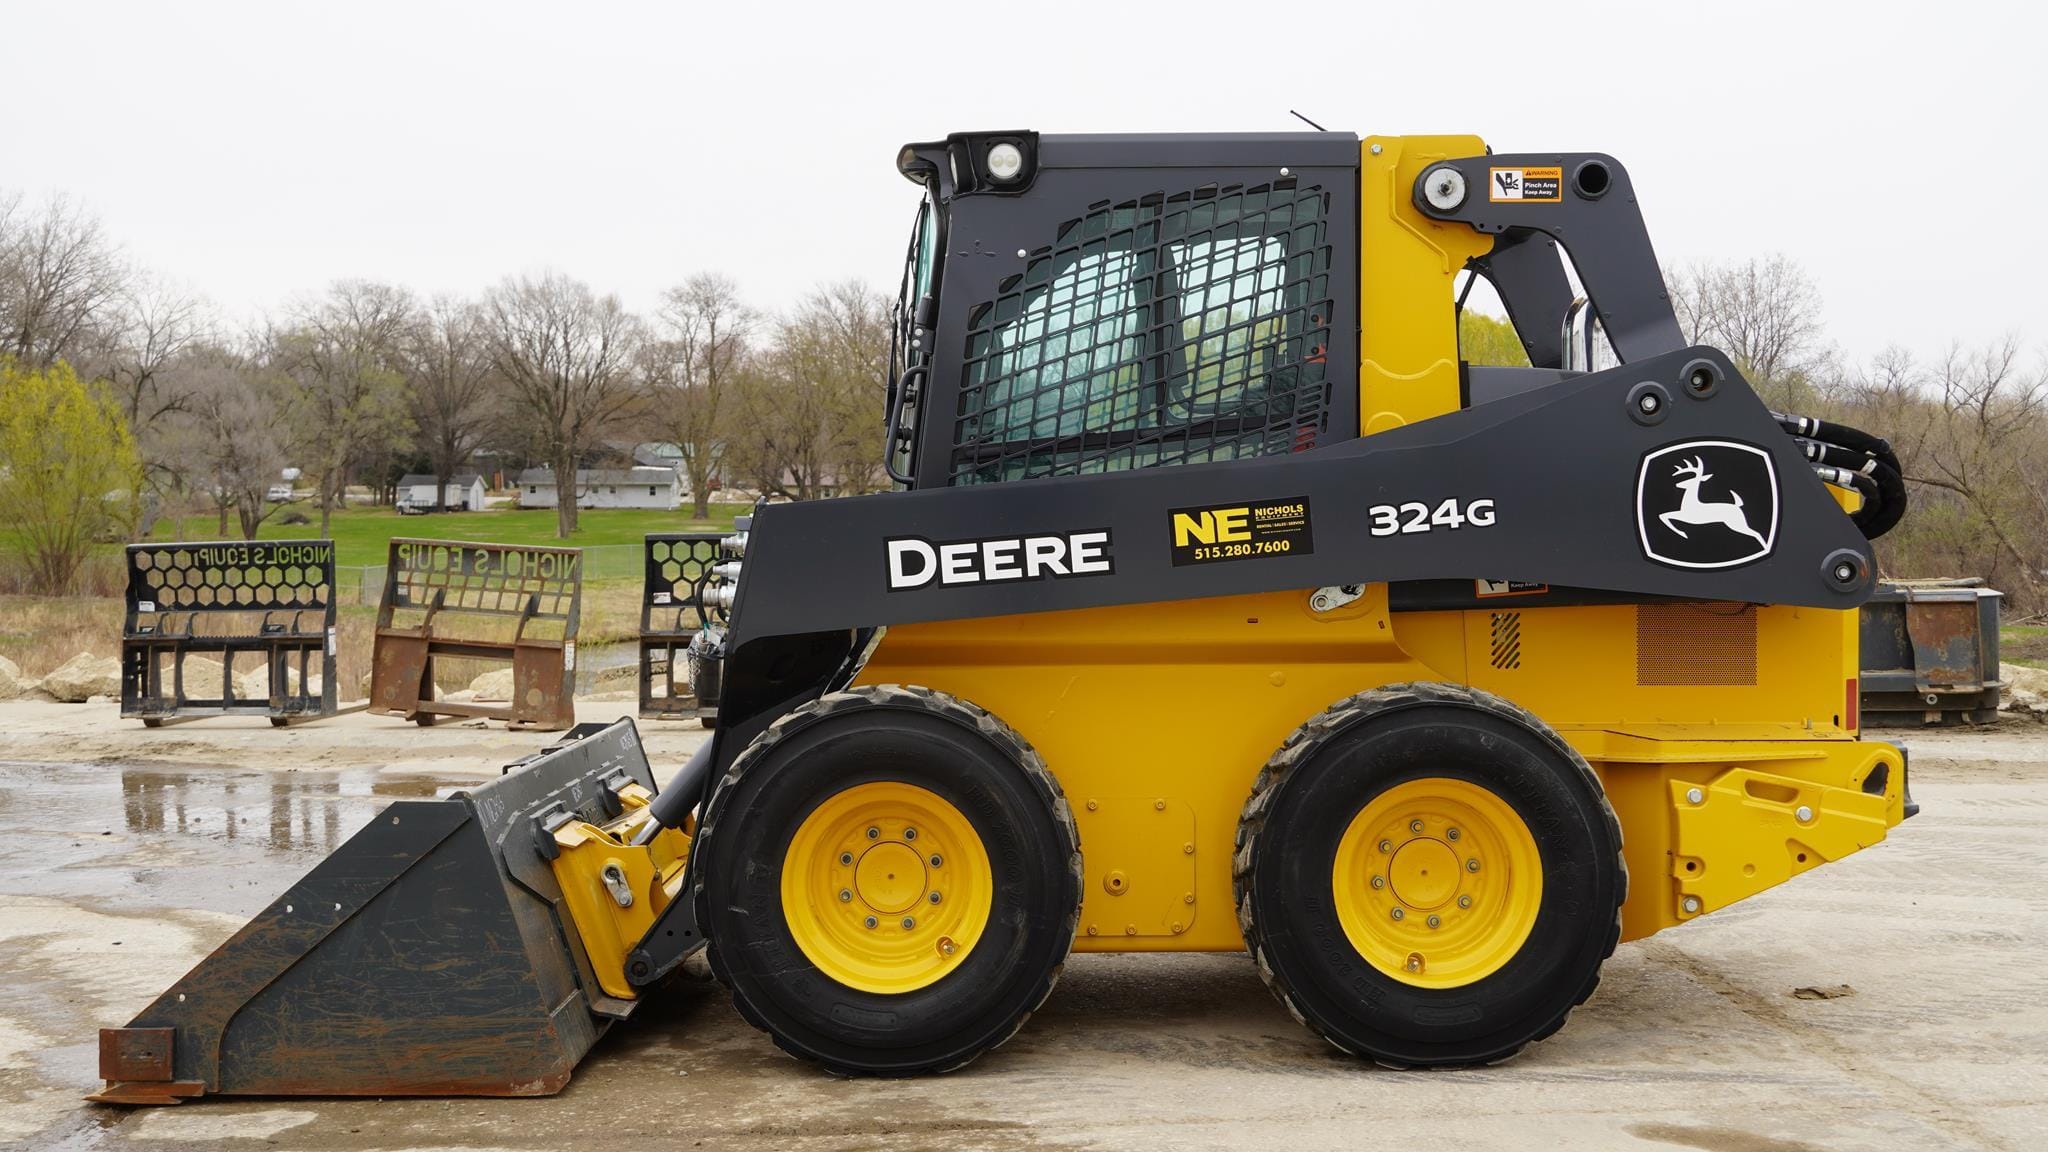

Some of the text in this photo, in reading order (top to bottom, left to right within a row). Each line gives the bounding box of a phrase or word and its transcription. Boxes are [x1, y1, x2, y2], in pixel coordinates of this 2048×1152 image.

[1173, 507, 1252, 547] NE
[1254, 504, 1304, 516] NICHOLS
[1369, 498, 1496, 536] 324G
[887, 532, 1110, 588] DEERE
[1194, 540, 1290, 560] 515.280.7600
